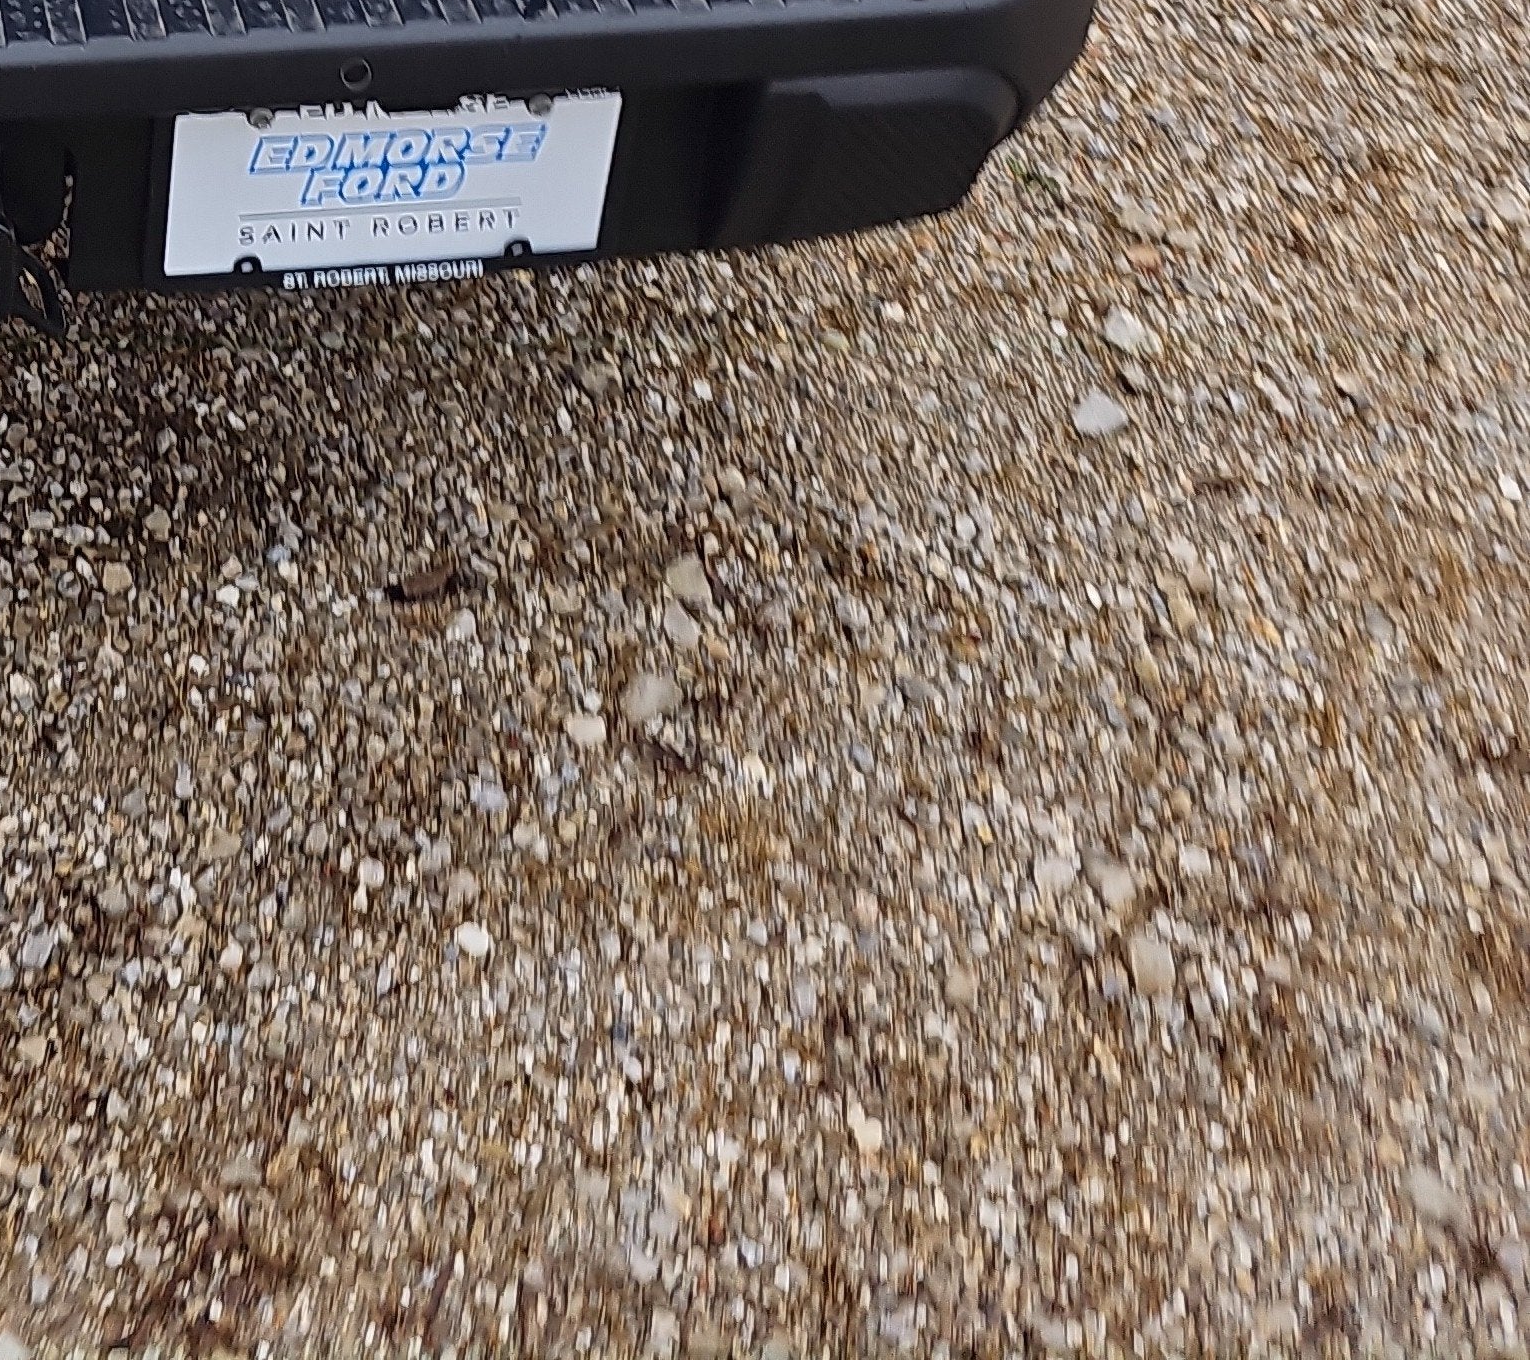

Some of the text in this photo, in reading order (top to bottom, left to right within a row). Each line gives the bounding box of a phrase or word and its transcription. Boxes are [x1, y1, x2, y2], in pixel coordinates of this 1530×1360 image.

[301, 162, 467, 206] FORD
[238, 206, 521, 246] SAINT ROBERT
